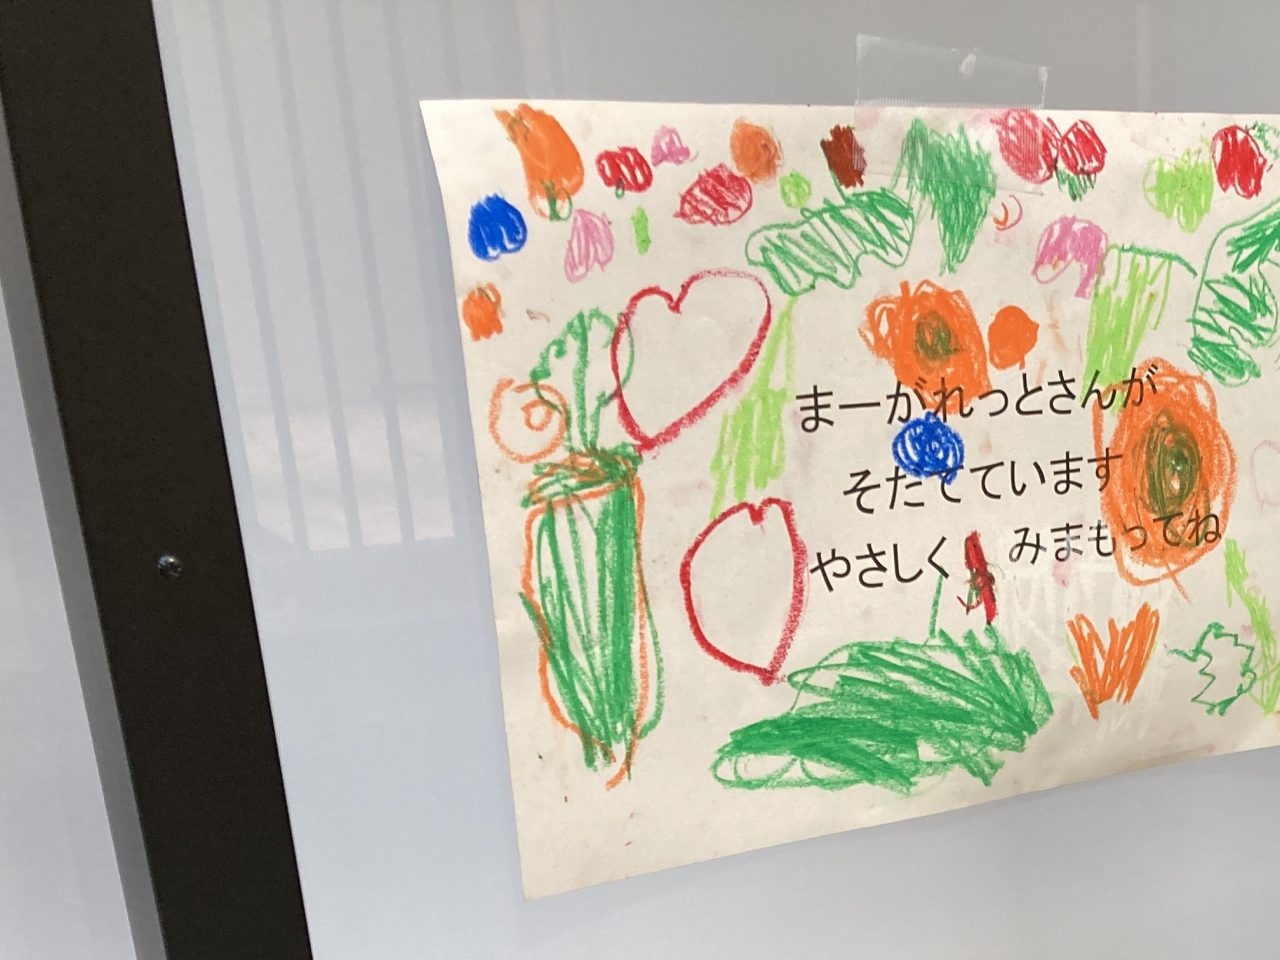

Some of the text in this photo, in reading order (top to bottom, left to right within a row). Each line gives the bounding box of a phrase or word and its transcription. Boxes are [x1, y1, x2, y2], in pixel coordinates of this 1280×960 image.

[795, 363, 1160, 433] まーがれっとさんが
[808, 512, 1223, 593] やさしく みまもってね
